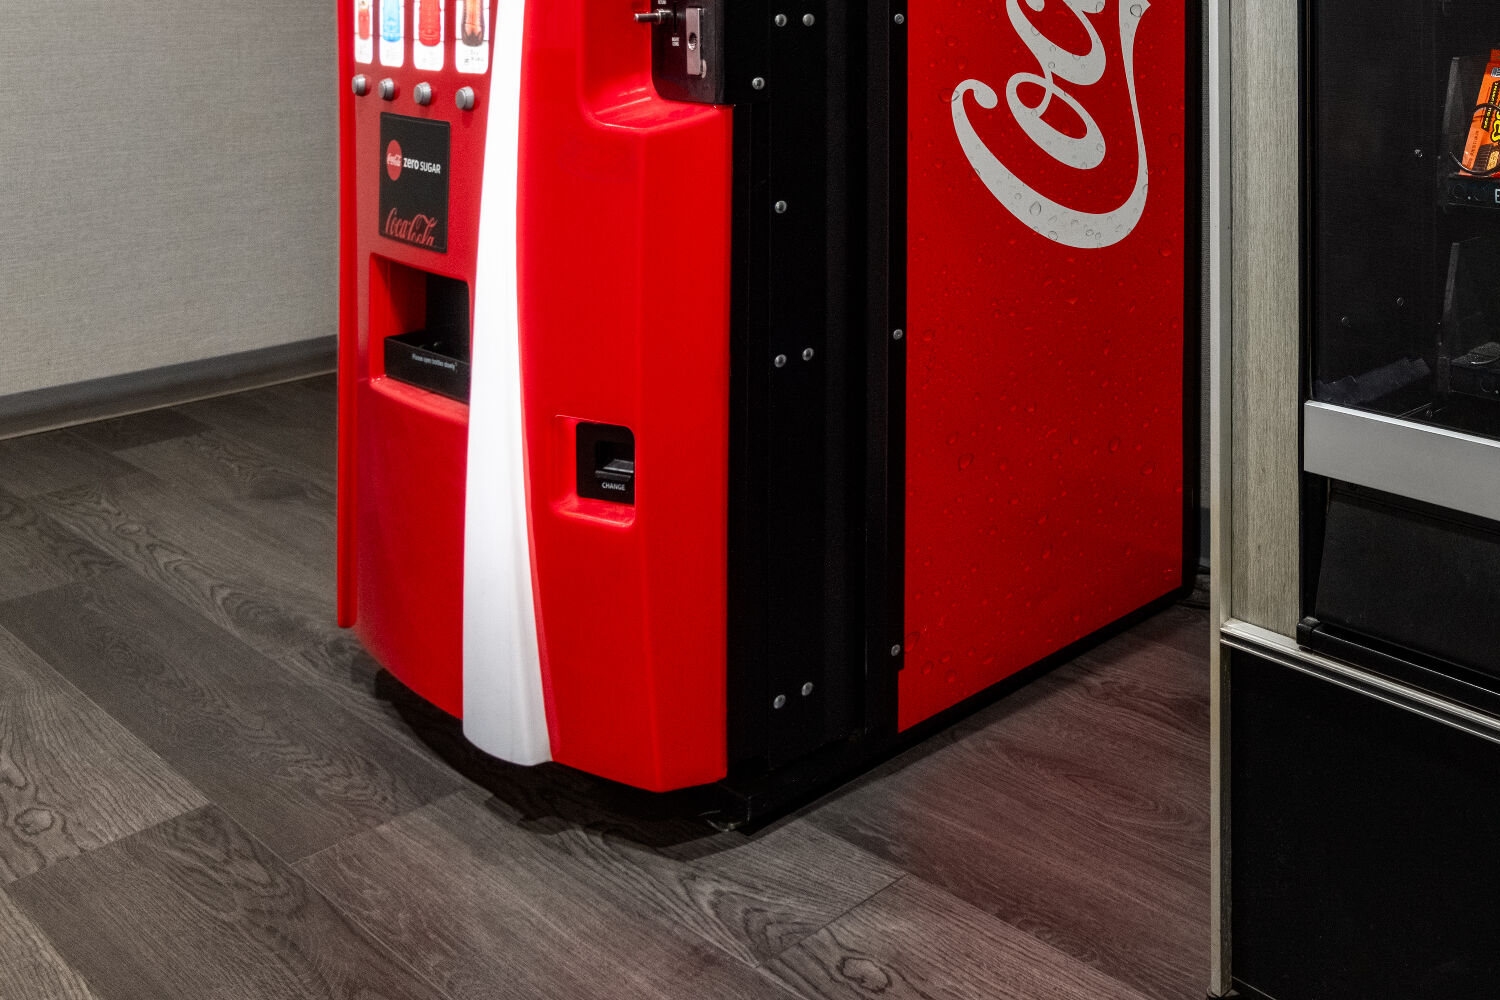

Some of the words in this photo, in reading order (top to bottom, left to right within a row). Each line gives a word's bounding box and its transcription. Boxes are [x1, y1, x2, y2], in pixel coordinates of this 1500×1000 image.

[403, 157, 420, 170] zero
[420, 161, 441, 174] SUGAR
[601, 481, 625, 491] CHANGE
